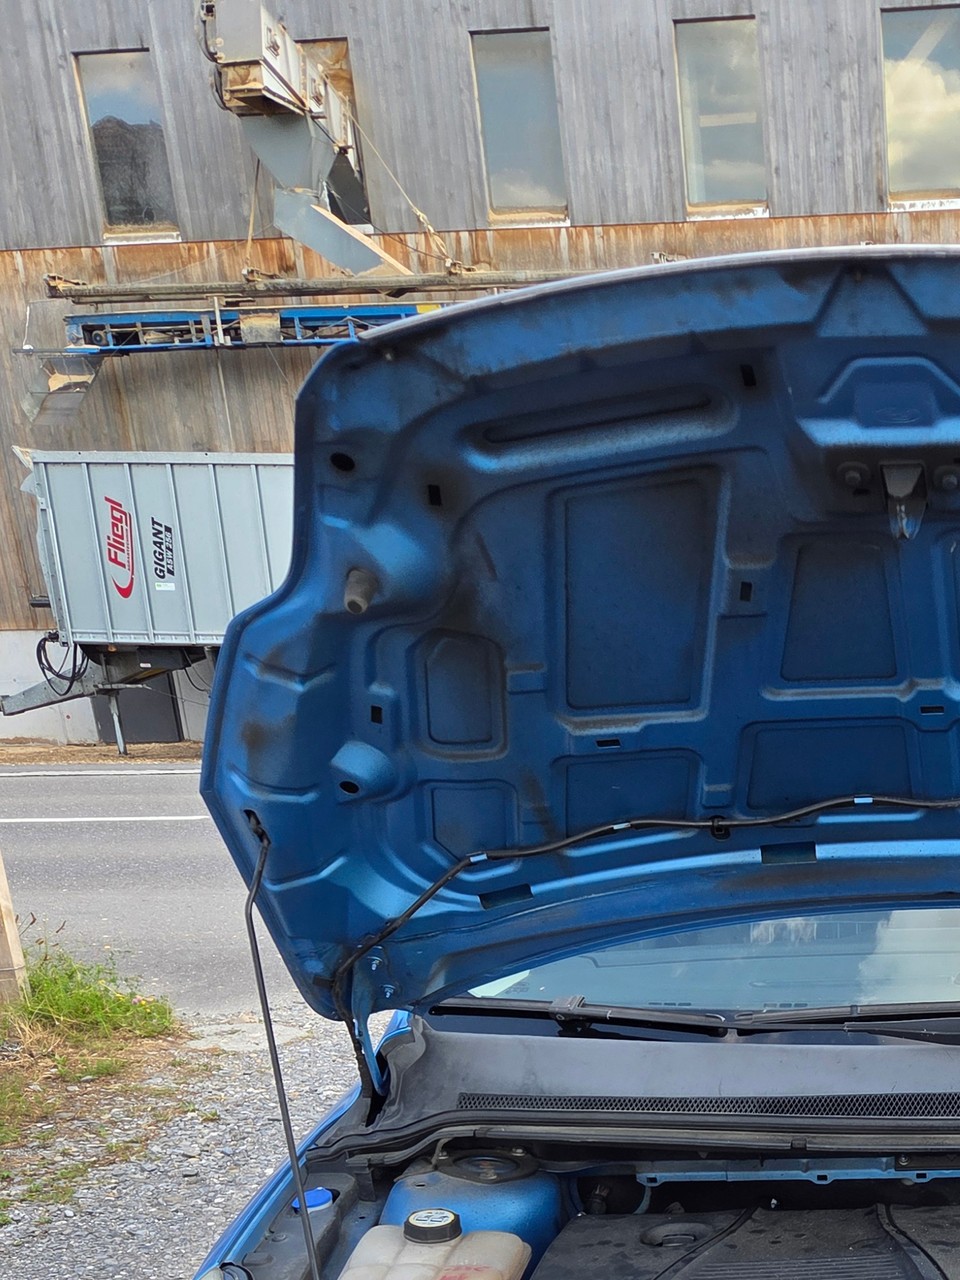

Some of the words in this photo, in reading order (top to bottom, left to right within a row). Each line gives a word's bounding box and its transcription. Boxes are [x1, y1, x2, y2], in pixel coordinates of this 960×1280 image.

[104, 495, 129, 570] Fliegl
[151, 517, 166, 579] GIGANT
[165, 531, 173, 549] 256
[165, 549, 174, 571] ASW
